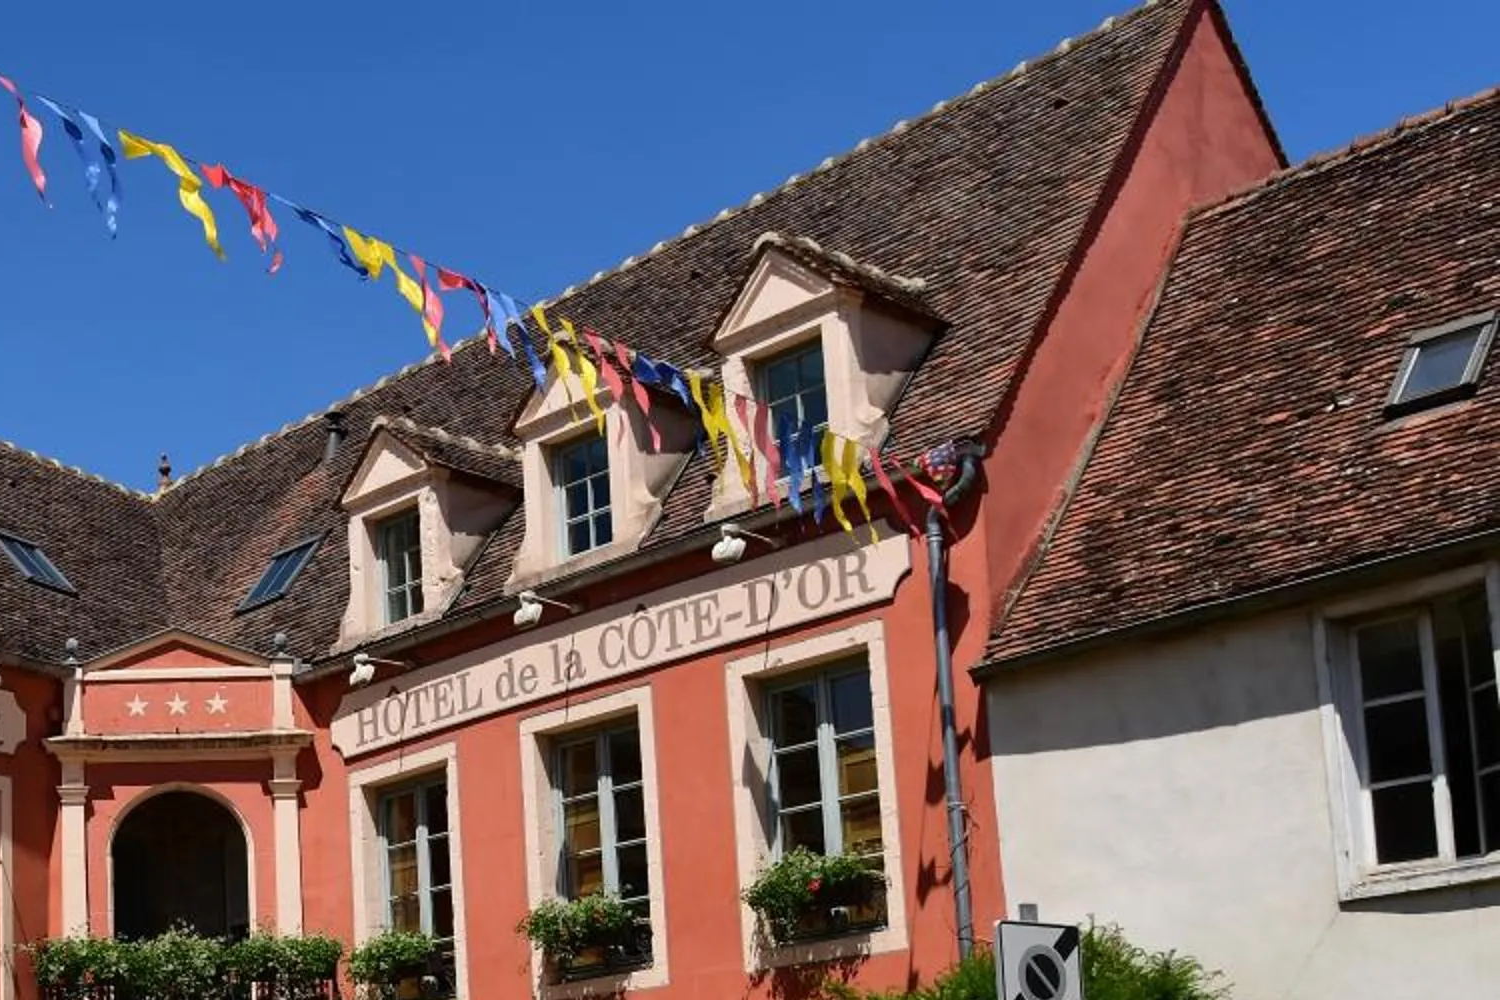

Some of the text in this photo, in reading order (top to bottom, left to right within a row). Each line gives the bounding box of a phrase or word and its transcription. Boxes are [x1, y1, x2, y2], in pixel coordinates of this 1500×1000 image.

[355, 548, 875, 748] HÔTEL de la CÔTE-D'OR
